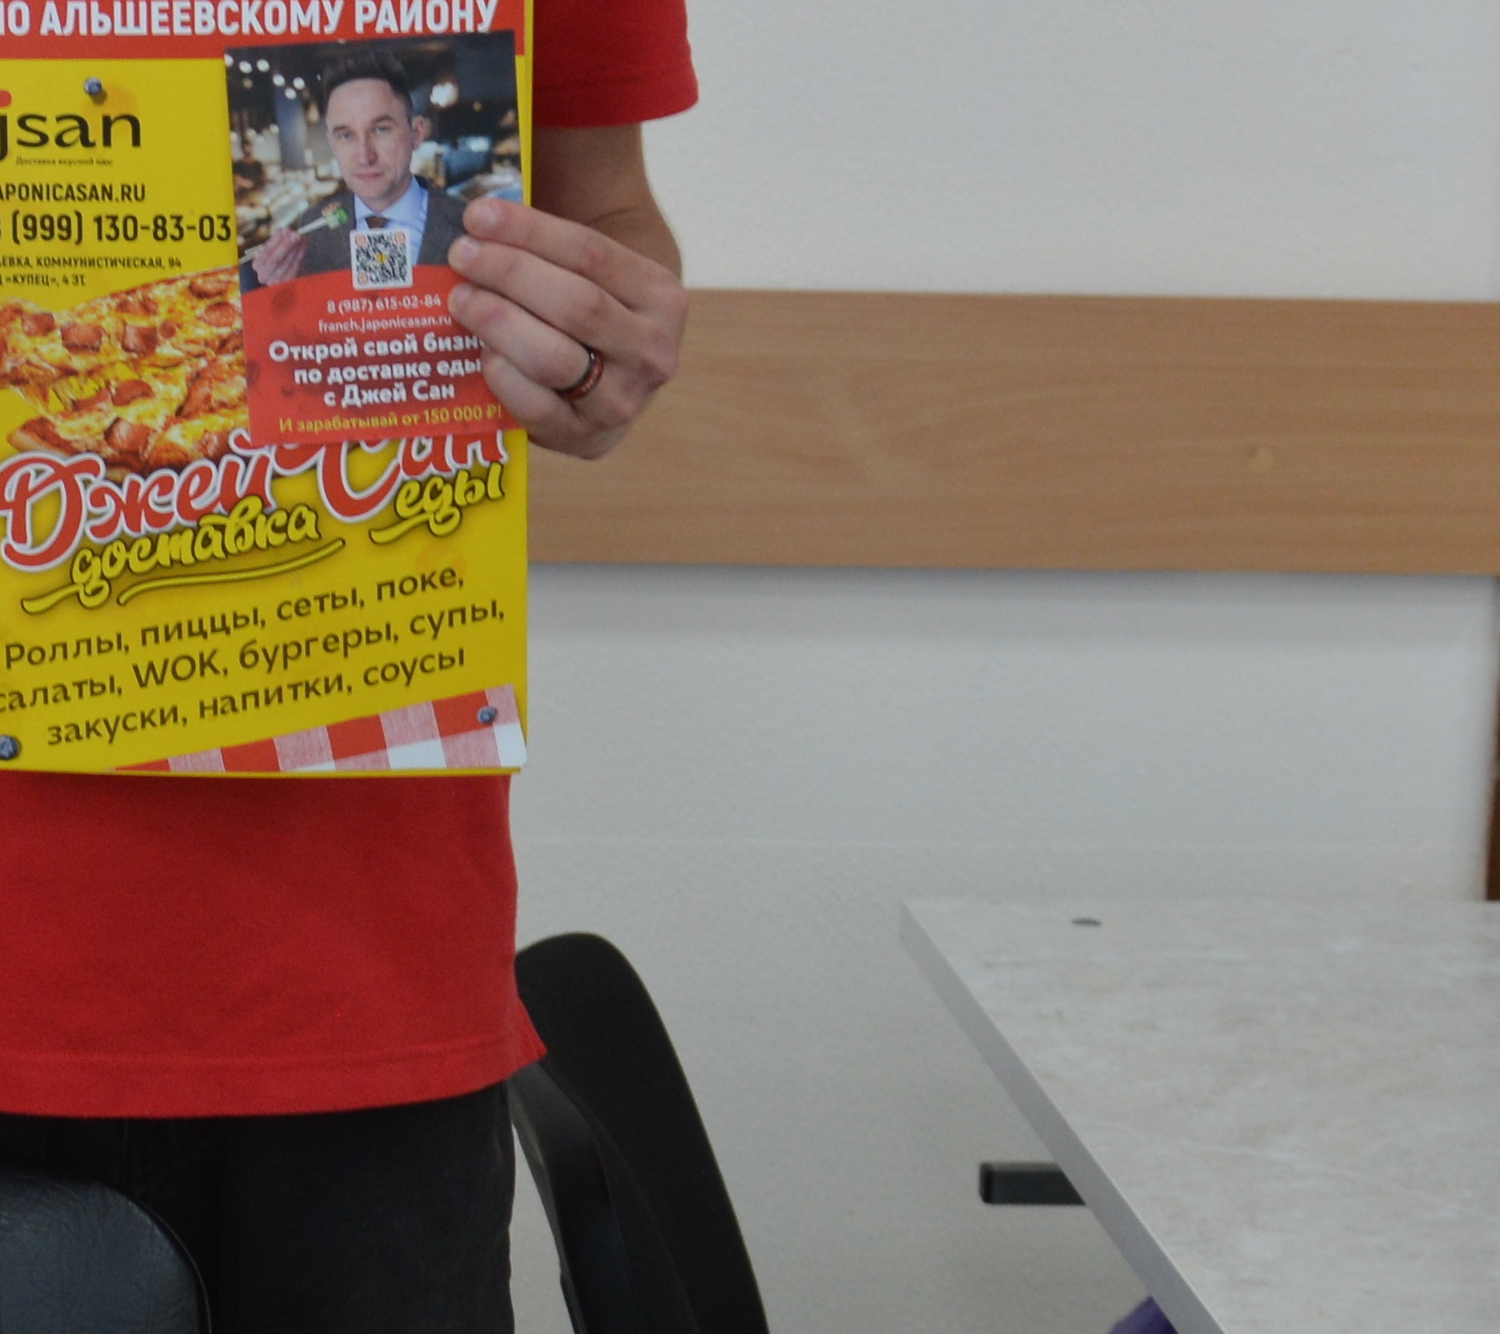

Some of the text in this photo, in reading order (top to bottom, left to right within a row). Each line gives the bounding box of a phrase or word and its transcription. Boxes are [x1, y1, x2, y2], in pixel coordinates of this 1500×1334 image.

[11, 209, 83, 245] (999)
[93, 214, 232, 242] 130-83-03
[36, 256, 166, 270] КОММУНИСТИЧЕСКАЯ,
[327, 300, 336, 313] 8
[338, 298, 373, 315] (987)
[268, 331, 487, 364] Открой свой бизн
[294, 357, 482, 385] по доставке еды
[323, 379, 456, 409] с Джей Сан
[279, 417, 293, 434] И
[297, 412, 398, 435] зарабатывай
[402, 410, 420, 424] от
[424, 407, 450, 424] 150
[453, 405, 483, 422] 000
[21, 461, 505, 615] доставка еды
[4, 566, 464, 669] Роллы, пиццы, сеты, поке,
[132, 649, 229, 690] WOK,
[238, 619, 400, 675] бургеры,
[408, 599, 505, 643] супы,
[46, 647, 465, 747] закуски, напитки, соусы
